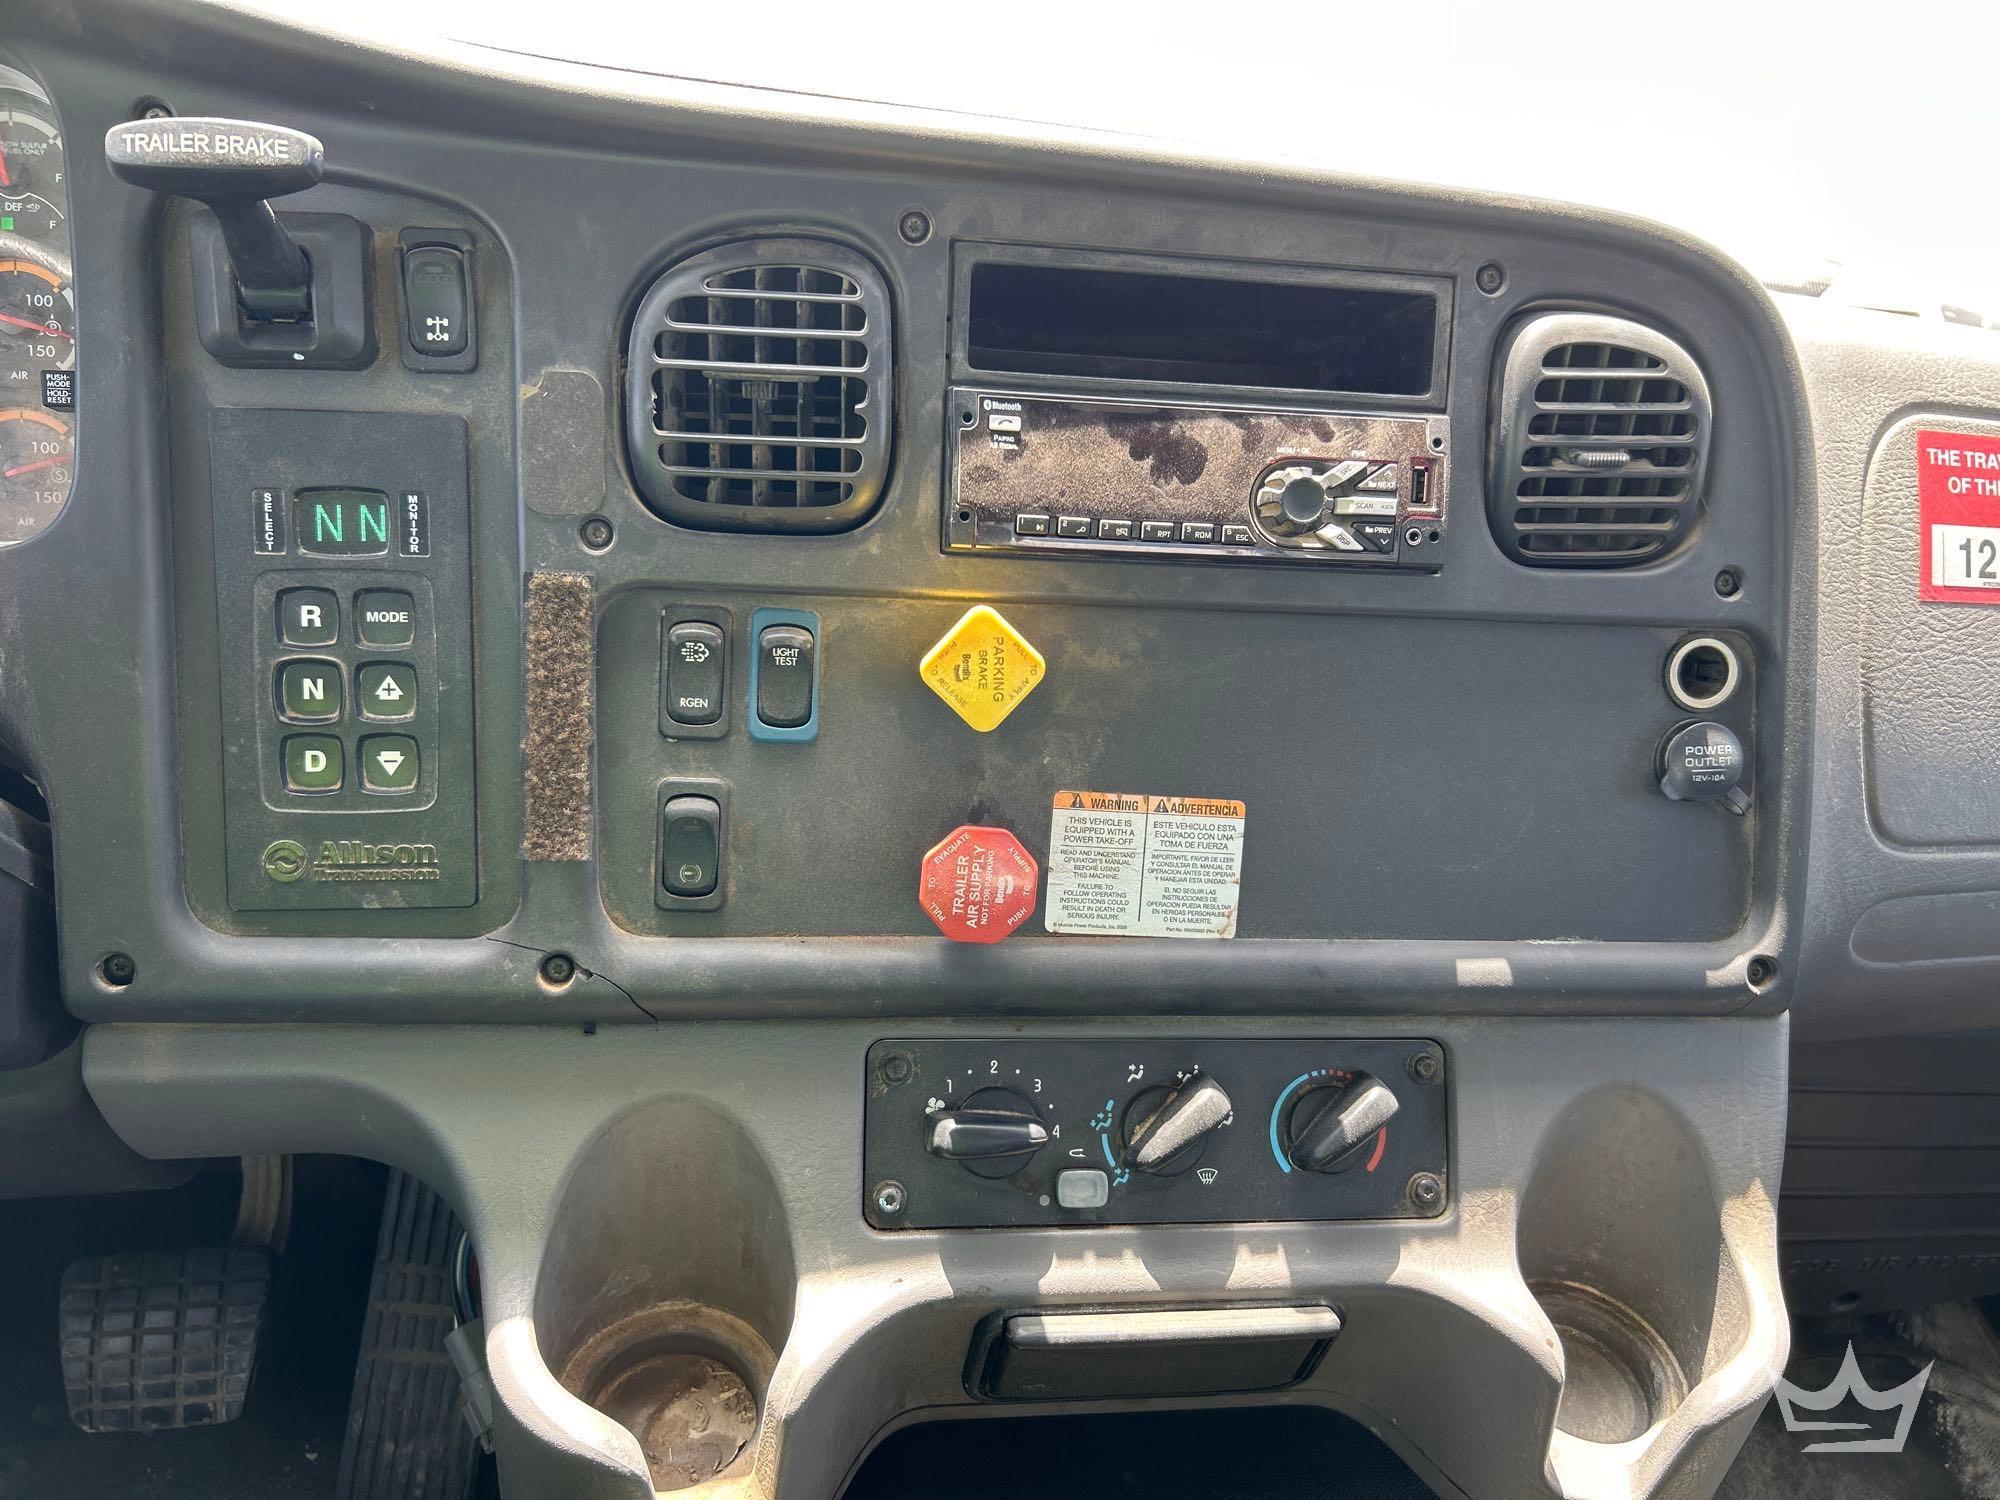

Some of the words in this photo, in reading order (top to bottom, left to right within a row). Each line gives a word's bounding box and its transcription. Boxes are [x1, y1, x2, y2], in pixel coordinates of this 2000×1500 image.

[121, 133, 210, 153] TRAILER
[214, 134, 289, 159] BRAKE
[56, 173, 62, 183] F
[5, 202, 23, 212] DEF
[50, 220, 56, 229] F
[25, 294, 53, 307] 100
[27, 344, 56, 358] 150
[11, 371, 28, 380] AIR
[46, 380, 71, 388] MODE
[47, 396, 72, 404] RESET
[992, 400, 1022, 411] Bluetooth
[32, 442, 59, 454] 100
[1926, 447, 1961, 468] THE
[1963, 450, 2000, 470] TRA
[1948, 476, 1972, 495] OF
[1974, 478, 2000, 496] TH
[35, 491, 62, 503] 150
[17, 518, 35, 526] AIR
[263, 492, 275, 551] SELECT
[316, 504, 343, 542] N
[360, 504, 386, 542] N
[408, 495, 420, 553] MONITOR
[1157, 530, 1171, 538] RPT
[1336, 535, 1351, 545] DISP
[1959, 537, 1997, 579] 12
[301, 605, 322, 627] R
[366, 611, 409, 623] MODE
[772, 648, 799, 657] LIGHT
[775, 657, 797, 666] TEST
[979, 650, 987, 689] BRAKE
[993, 637, 1004, 702] PARKING
[303, 678, 324, 700] N
[938, 679, 968, 708] RELEASE
[680, 698, 708, 708] RGEN
[1685, 744, 1733, 756] POWER
[305, 750, 327, 772] D
[1685, 756, 1732, 767] OUTLET
[1091, 798, 1139, 811] WARNING
[1170, 803, 1238, 816] ADVERTENCIA
[1069, 817, 1087, 825] THIS
[1089, 817, 1122, 826] VEHICLE
[1154, 821, 1174, 829] ESTE
[1065, 826, 1105, 835] EQUIPPED
[1107, 828, 1128, 836] WITH
[1155, 831, 1195, 839] EQUIPADO
[1064, 835, 1094, 844] POWER
[1095, 837, 1134, 845] TAKE-OFF
[1160, 840, 1183, 848] TOMA
[1197, 842, 1228, 850] FUERZA
[314, 840, 438, 864] Allison
[934, 832, 970, 864] EVACUATE
[1008, 847, 1032, 873] SUPPLY
[970, 845, 986, 900] SUPPLY
[985, 850, 995, 886] PARKING
[928, 877, 936, 888] TO
[952, 855, 969, 915] TRAILER
[1023, 885, 1031, 896] TO
[983, 888, 991, 908] FOR
[930, 902, 946, 922] PULL
[966, 905, 979, 928] AIR
[1008, 907, 1027, 926] PUSH
[990, 1060, 998, 1074] 2
[947, 1079, 952, 1093] 1
[1034, 1078, 1042, 1092] 3
[1052, 1124, 1060, 1138] 4
